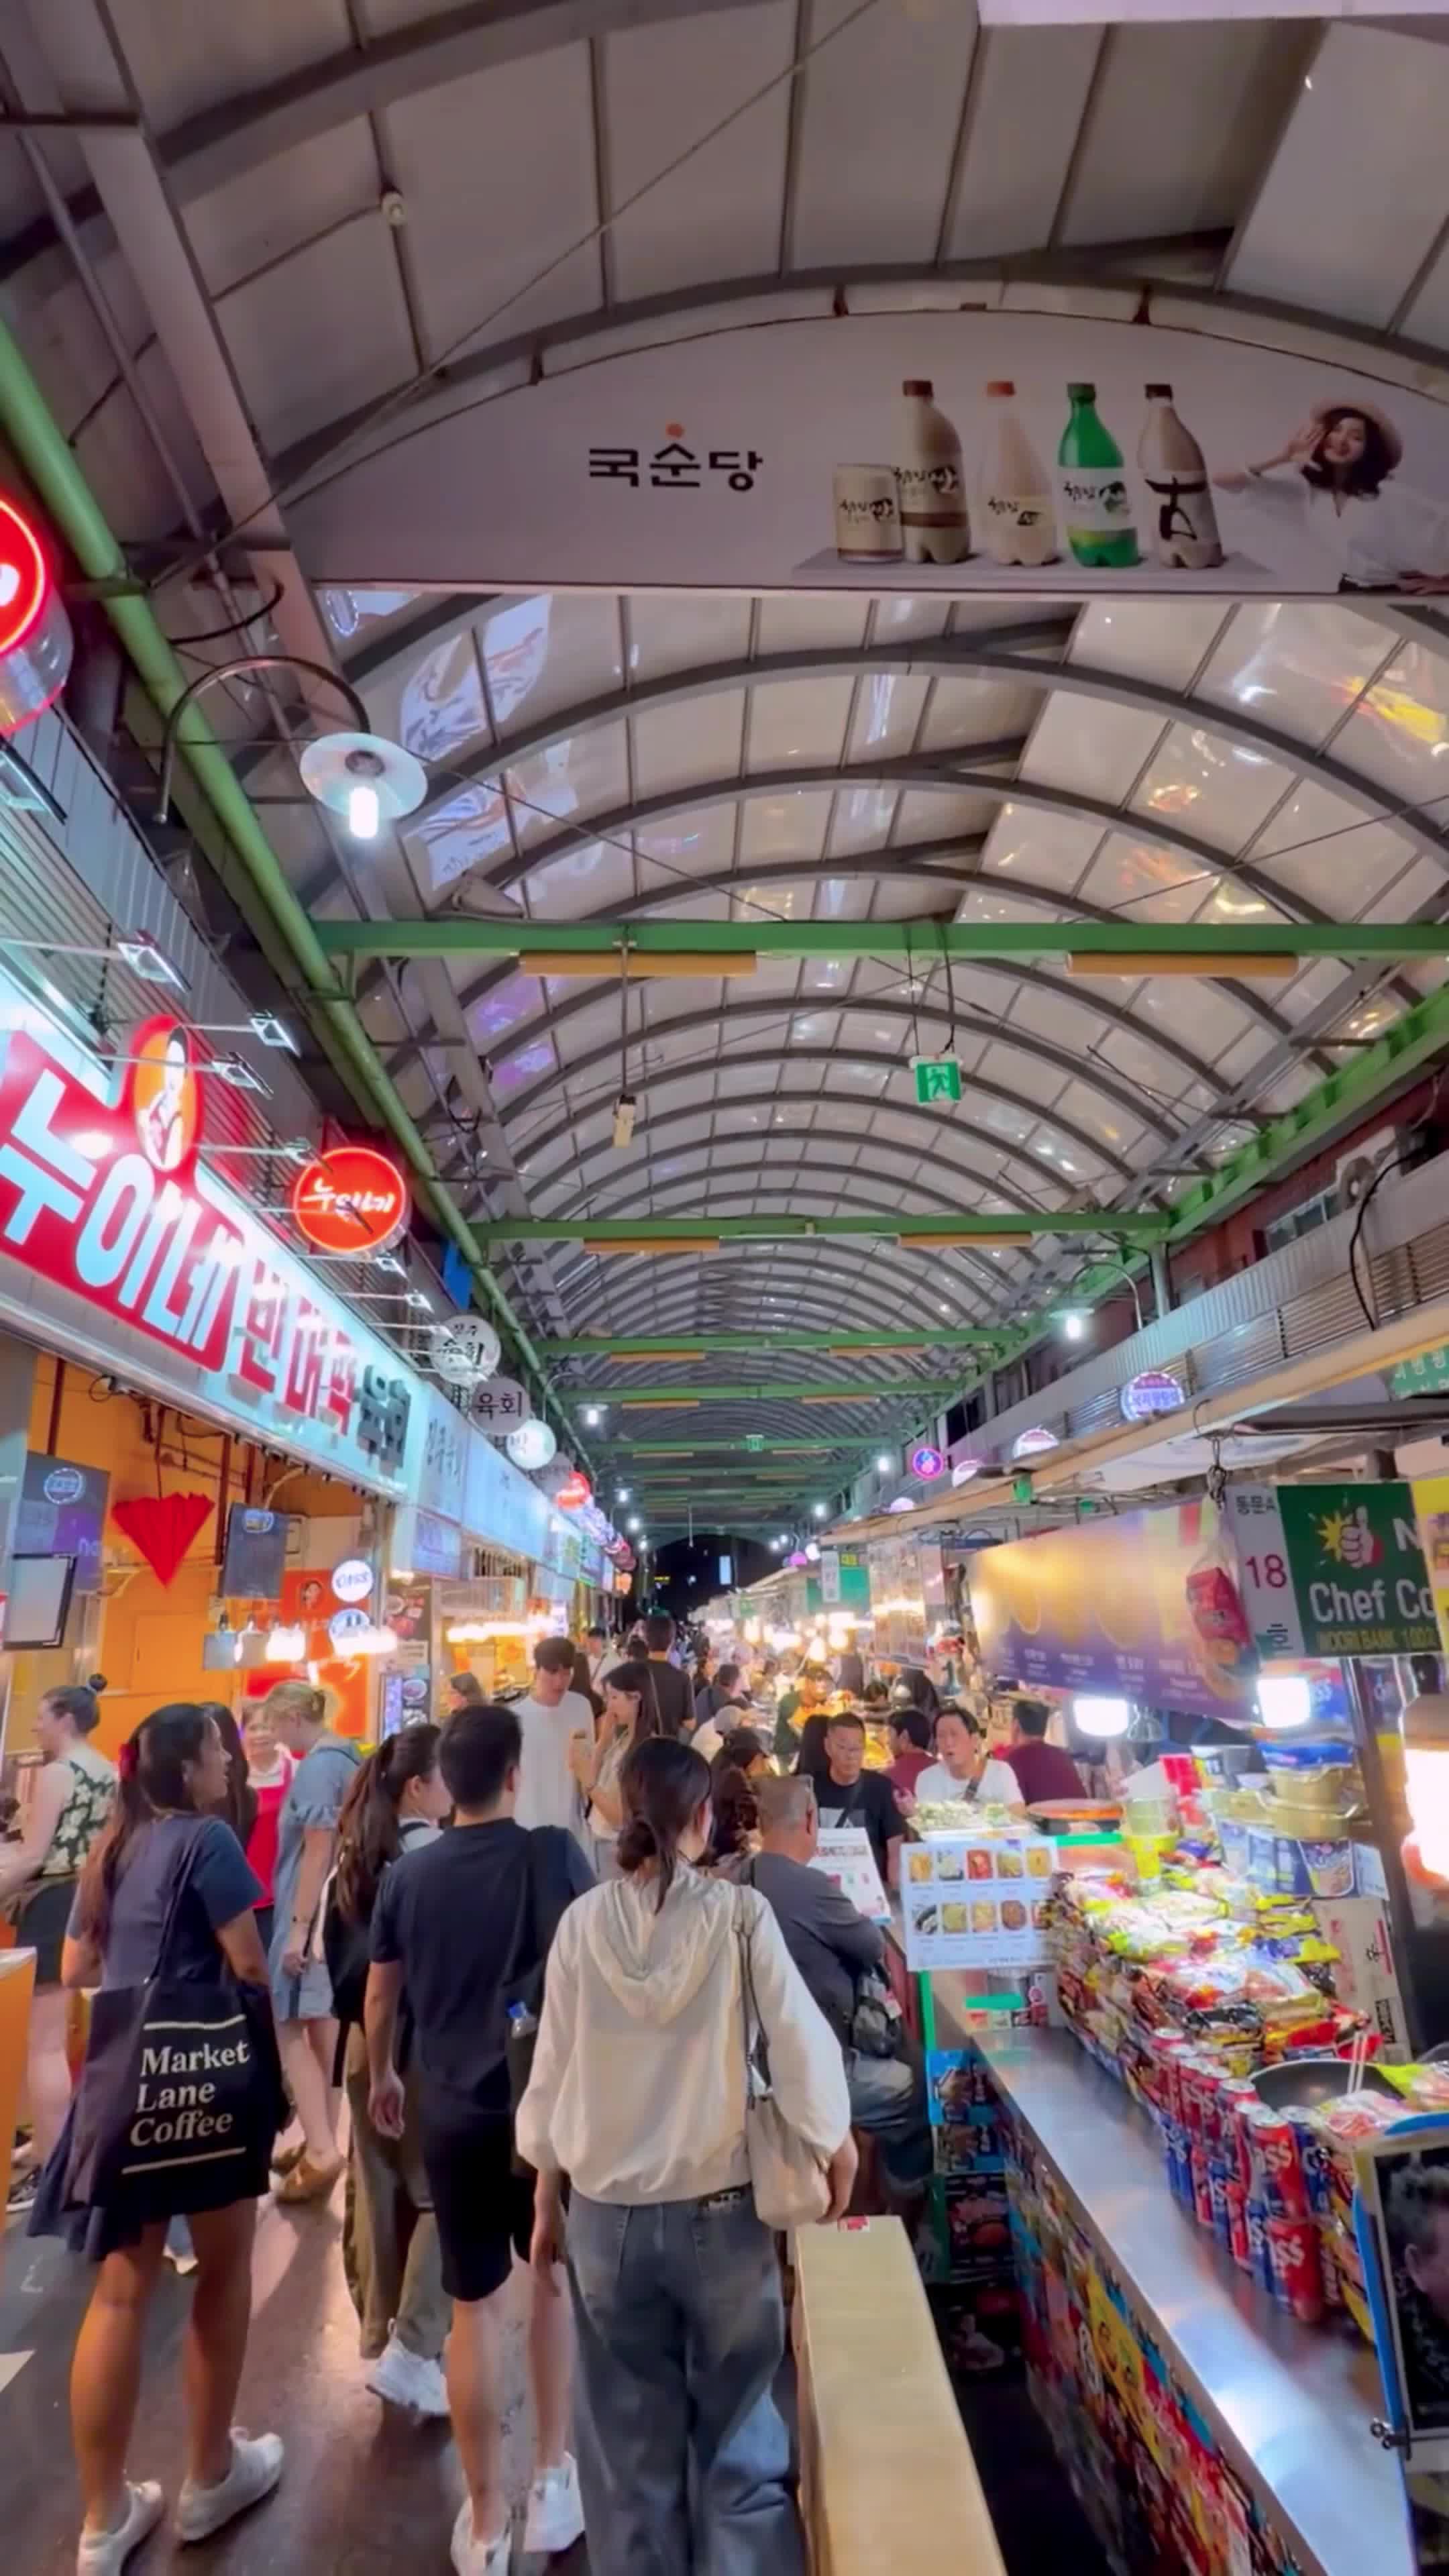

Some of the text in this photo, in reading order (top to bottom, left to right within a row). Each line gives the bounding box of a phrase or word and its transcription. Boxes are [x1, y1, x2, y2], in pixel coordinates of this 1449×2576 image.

[588, 443, 763, 492] 국순당
[476, 1391, 522, 1419] 육회
[1244, 1554, 1287, 1589] 18
[1309, 1579, 1385, 1623] Chef
[140, 2039, 251, 2078] Market
[136, 2082, 216, 2113] Lane
[129, 2109, 233, 2147] Coffee
